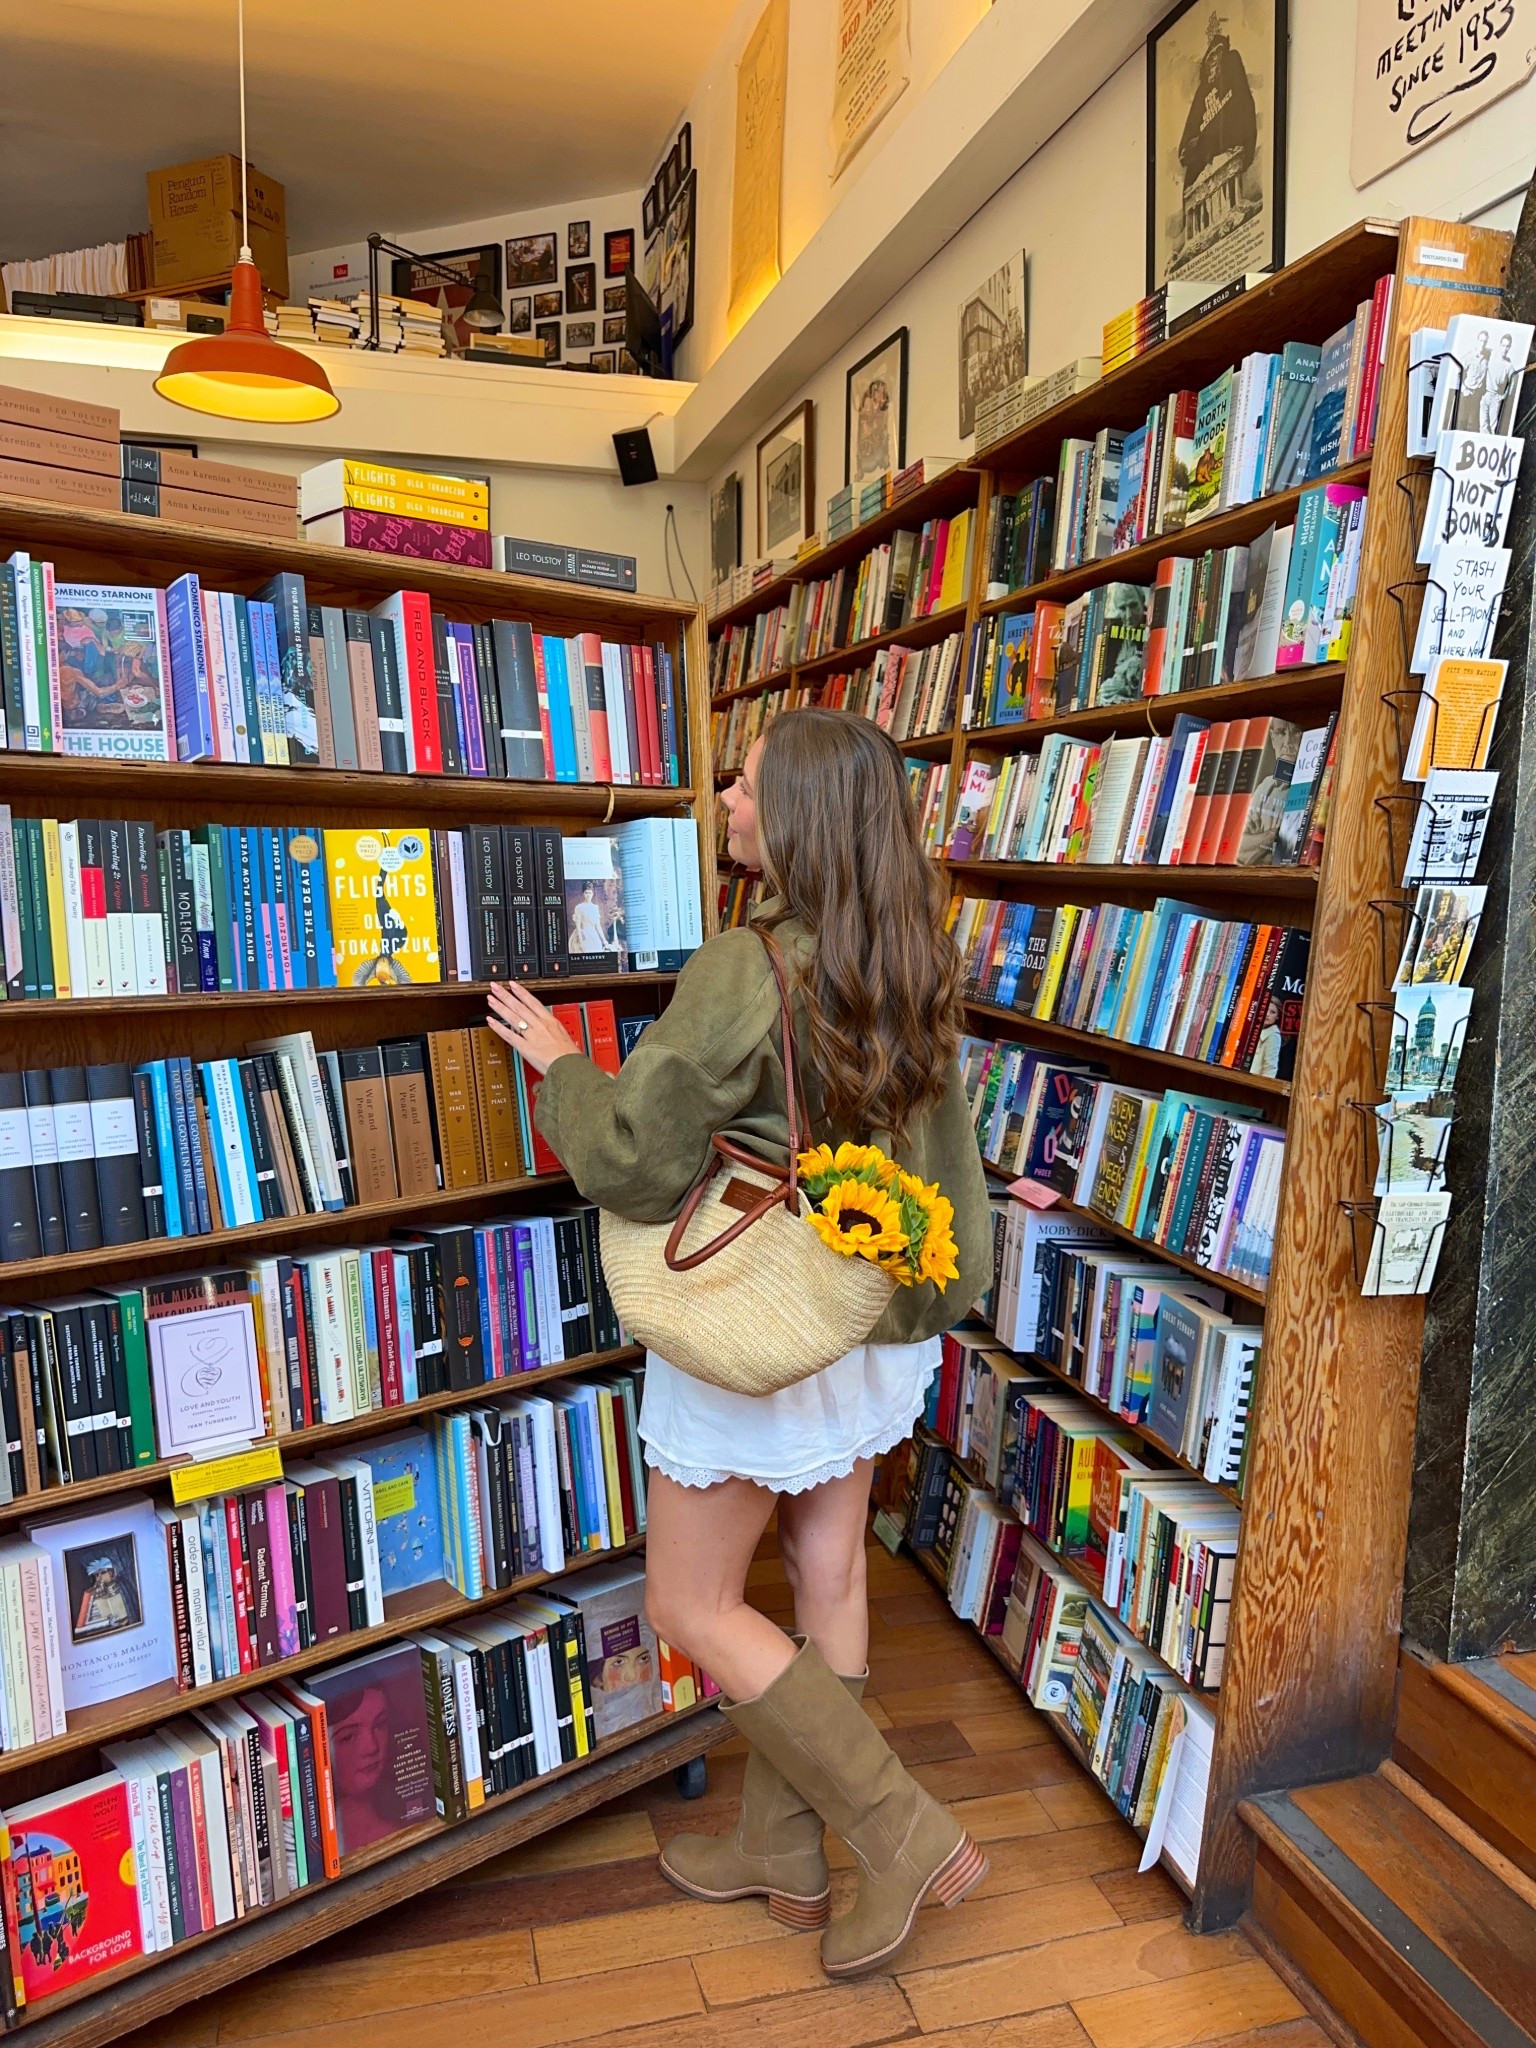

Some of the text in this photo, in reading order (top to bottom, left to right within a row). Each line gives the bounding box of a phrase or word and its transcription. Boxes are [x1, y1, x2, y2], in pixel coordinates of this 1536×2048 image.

[1389, 0, 1515, 113] SINCE 1953
[168, 176, 206, 191] Penguin
[169, 188, 207, 205] Random
[170, 204, 198, 218] House
[1200, 290, 1231, 315] THE ROAD
[1295, 358, 1320, 370] ANAT
[1332, 338, 1352, 360] IN TH
[1326, 358, 1349, 380] COUNT
[1327, 384, 1336, 394] OF
[49, 406, 114, 426] LEO TOLSTOY
[1198, 398, 1228, 431] NORTH
[1194, 418, 1227, 450] WOODS
[49, 441, 114, 459] LEO TOLSTOY
[1456, 440, 1517, 488] BOOKS
[49, 477, 114, 494] LEO TOLSTOY
[167, 466, 293, 492] Anna Karenina TOLSTOY
[354, 467, 467, 498] FLIGHTS OLGA TOKARCZUK
[1456, 478, 1496, 508] NOT
[166, 499, 292, 523] Anna Karenina TOLSTOY
[353, 490, 466, 520] FLIGHTS OLGA TOKARCZUK
[1308, 495, 1320, 544] ARMISTEAD
[1300, 496, 1314, 546] MAUPIN
[1441, 507, 1503, 548] BOMBS
[516, 551, 563, 567] LEO TOLSTOY
[1453, 559, 1497, 578] STASH
[102, 590, 153, 600] STARNONE
[1453, 581, 1486, 602] YOUR
[2, 582, 13, 666] PETER STAMM
[190, 580, 209, 695] DOMENICO STARNONE TIES
[1447, 628, 1465, 639] AND
[1442, 646, 1466, 657] HERE
[413, 611, 431, 740] RED AND BLACK
[101, 737, 165, 753] HOUSE
[272, 836, 283, 894] THE BONES
[482, 836, 493, 890] LEO TOLSTOY
[514, 838, 525, 891] LEO TOLSTOY
[546, 839, 556, 891] LEO TOLSTOY
[240, 836, 255, 962] DRIVE YOUR PLOW OVER
[335, 874, 428, 900] FLIGHTS
[178, 891, 195, 955] MORENGA
[301, 869, 316, 958] OF THE DEAD
[363, 908, 405, 931] OLGA
[265, 933, 273, 960] OLGA
[277, 915, 291, 975] TOKARCZUK
[339, 937, 432, 957] TOKARCZUK
[1028, 936, 1047, 953] THE
[1021, 953, 1046, 971] ROAD
[1226, 984, 1241, 1019] Saturday
[1247, 1000, 1258, 1022] Solar
[171, 1068, 189, 1153] TOLSTOY GOSPEL
[183, 1068, 202, 1153] TOLSTOY GOSPEL
[356, 1097, 365, 1127] Peace
[365, 1088, 378, 1131] War and
[399, 1091, 409, 1121] Peace
[408, 1082, 421, 1126] War and
[449, 1104, 466, 1112] PEACE
[491, 1097, 507, 1106] PEACE
[1111, 1097, 1137, 1122] EVEN-
[370, 1146, 381, 1192] TOLSTOY
[412, 1140, 424, 1183] TOLSTOY
[1096, 1180, 1121, 1208] ENDS
[1038, 1224, 1106, 1238] MOBY-DICK
[380, 1263, 388, 1285] Linn
[382, 1286, 391, 1321] Ullmann
[1162, 1308, 1196, 1341] GREAT PERHAPS
[388, 1359, 396, 1383] Song
[180, 1395, 241, 1413] LOVE AND YOUTH
[187, 1416, 238, 1430] IVAN TURGENEV
[361, 1481, 375, 1546] VITTORINI
[187, 1535, 204, 1630] ordesa manuel
[257, 1547, 271, 1620] Radiant Terminus
[61, 1637, 160, 1673] MONTANO'S MALADY
[179, 1631, 190, 1666] MALADY
[71, 1652, 152, 1682] Enrique Vila-Matas
[441, 1677, 456, 1737] HOMELESS
[460, 1664, 473, 1733] MESOPOTAMIA
[249, 1734, 257, 1783] MARGUERITE
[93, 1795, 118, 1811] HELEN
[277, 1770, 292, 1808] THIRST
[304, 1763, 319, 1839] YEVGENY ZAMYATIN
[92, 1803, 118, 1819] WOLFF
[68, 1929, 132, 1965] BACKGROUND
[89, 1938, 133, 1968] FOR LOVE
